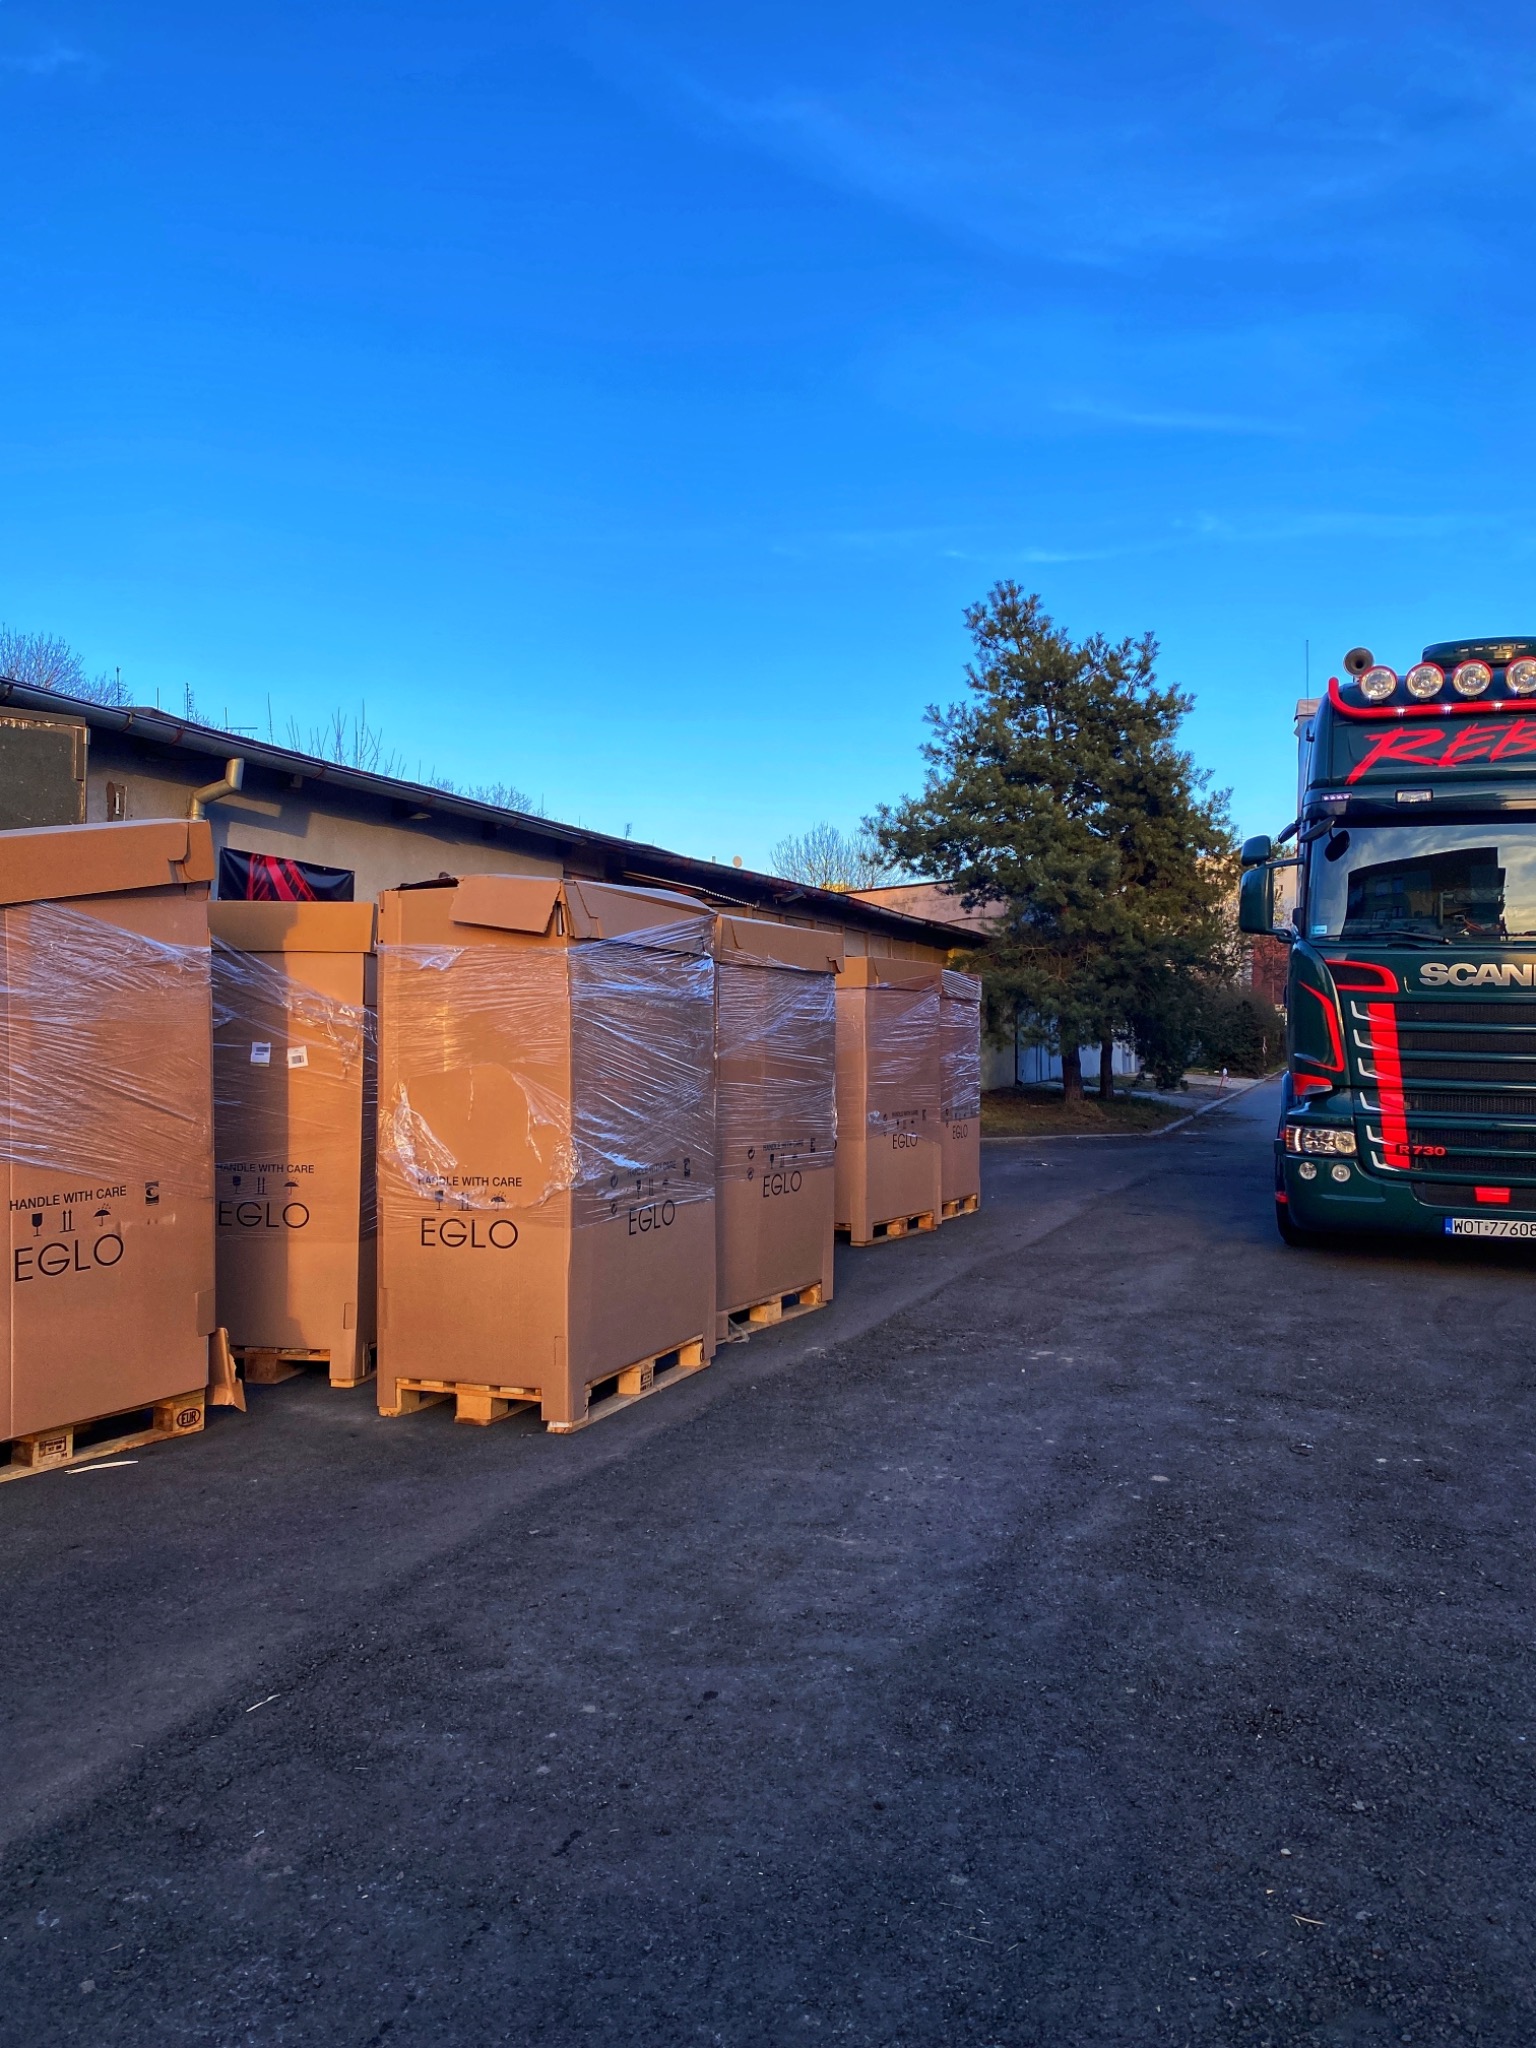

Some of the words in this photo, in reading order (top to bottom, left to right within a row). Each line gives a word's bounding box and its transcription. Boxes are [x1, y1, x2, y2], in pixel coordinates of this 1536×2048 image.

[892, 1132, 918, 1149] EGLO
[952, 1124, 969, 1140] EGLO
[1399, 1145, 1410, 1154] R
[1412, 1145, 1446, 1156] 730
[258, 1164, 284, 1173] WITH
[286, 1164, 315, 1174] CARE
[462, 1177, 489, 1186] WITH
[492, 1177, 522, 1187] CARE
[762, 1170, 802, 1198] EGLO
[9, 1194, 61, 1212] HANDLE
[63, 1189, 93, 1204] WITH
[96, 1185, 127, 1200] CARE
[218, 1201, 310, 1229] EGLO
[628, 1199, 676, 1236] EGLO
[421, 1217, 519, 1249] EGLO
[1454, 1220, 1484, 1234] WOT
[1489, 1222, 1536, 1237] 77608
[14, 1233, 124, 1282] EGLO
[181, 1410, 197, 1424] EUR
